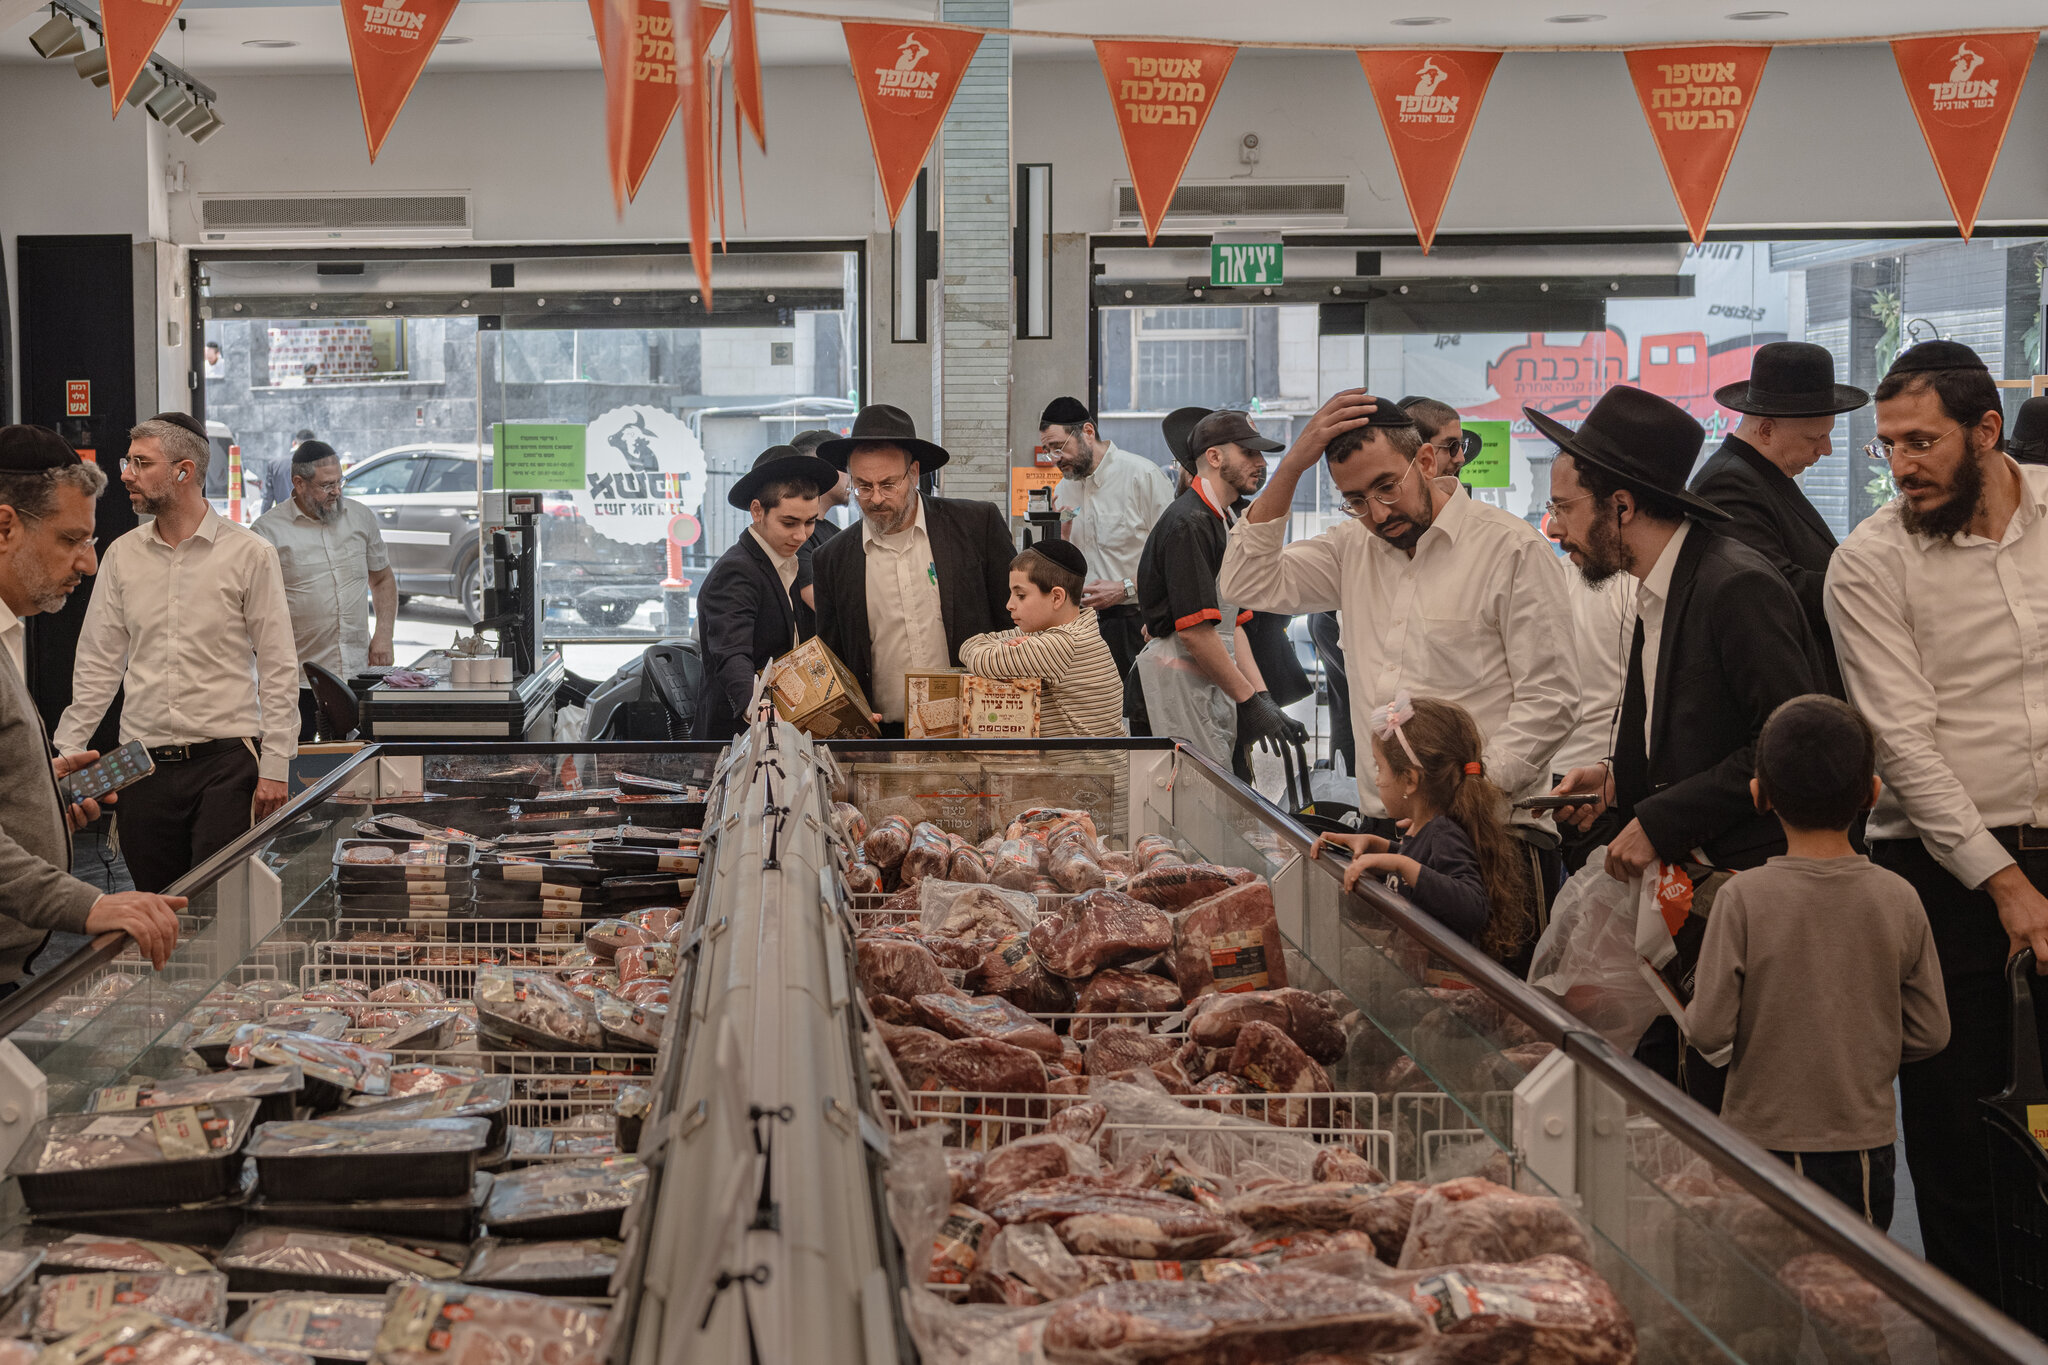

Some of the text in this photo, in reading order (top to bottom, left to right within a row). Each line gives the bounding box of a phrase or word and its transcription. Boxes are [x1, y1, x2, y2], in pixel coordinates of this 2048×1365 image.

[362, 4, 427, 31] אשפר
[634, 14, 674, 37] שפ
[364, 23, 420, 40] בשר אורגינל
[633, 60, 679, 84] הבש
[1127, 57, 1201, 79] אשפר
[1657, 63, 1736, 83] אשפר
[875, 67, 940, 90] אשפר
[877, 86, 934, 99] בשר אורגינל
[1120, 78, 1206, 103] ממלכת
[1651, 84, 1742, 108] ממלכת
[1928, 79, 1999, 100] אשפר
[1395, 94, 1460, 114] אשפר
[1933, 98, 1995, 111] בשר אורגינל
[1125, 103, 1197, 126] הבשר
[1399, 112, 1455, 124] בשר אורגינל
[1658, 108, 1734, 131] הבשר
[1219, 246, 1275, 283] יציאה
[1708, 304, 1766, 321] צעצועים
[1514, 357, 1623, 381] הרכבת
[1515, 382, 1552, 393] אחרת
[1555, 382, 1585, 393] קניה
[70, 402, 87, 412] אש
[981, 699, 1024, 712] נוה ציון
[941, 805, 966, 816] מצה
[935, 818, 973, 829] שמורה
